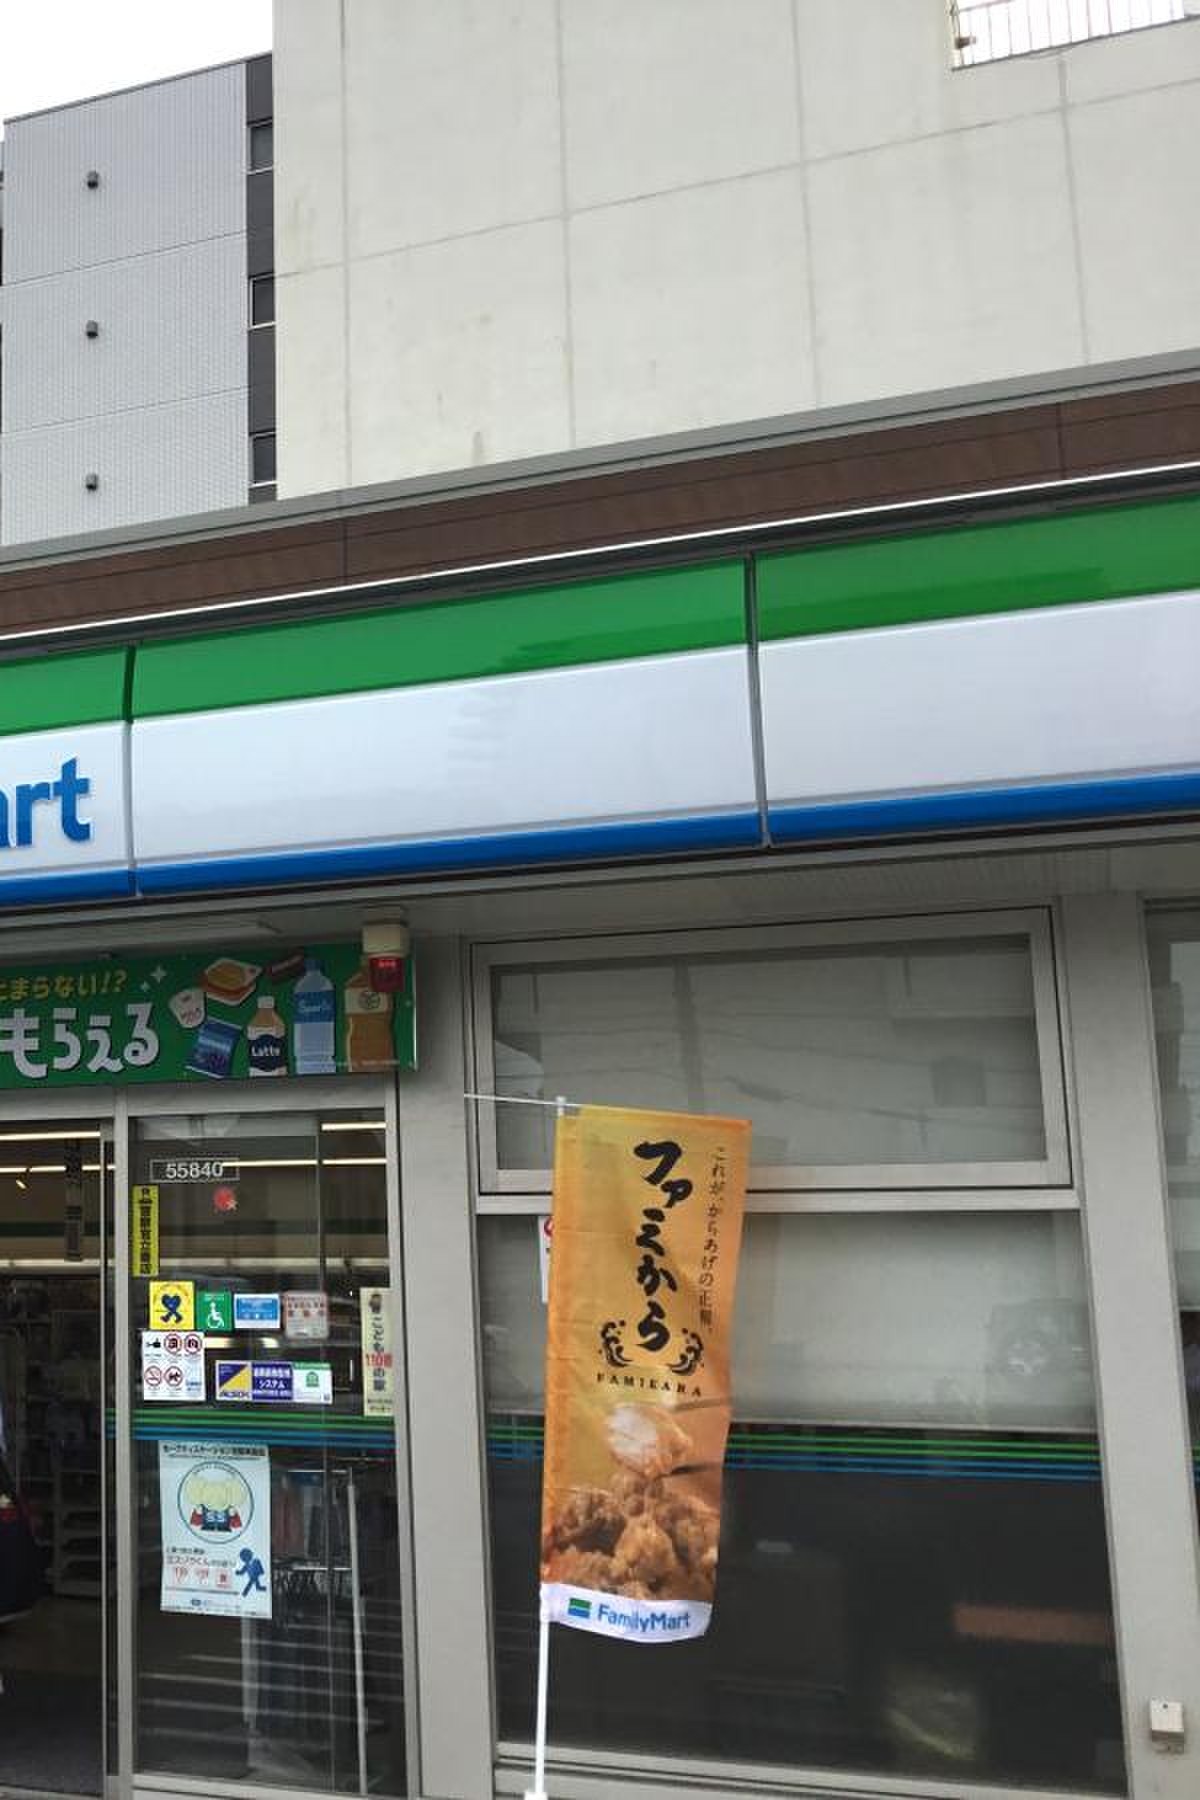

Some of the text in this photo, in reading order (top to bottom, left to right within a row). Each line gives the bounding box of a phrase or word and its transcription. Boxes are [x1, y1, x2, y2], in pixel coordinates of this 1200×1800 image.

[165, 1161, 223, 1180] 55840
[633, 1140, 694, 1353] ファミから
[596, 1372, 702, 1398] FAMIKARA
[598, 1603, 691, 1632] FamilyMart
